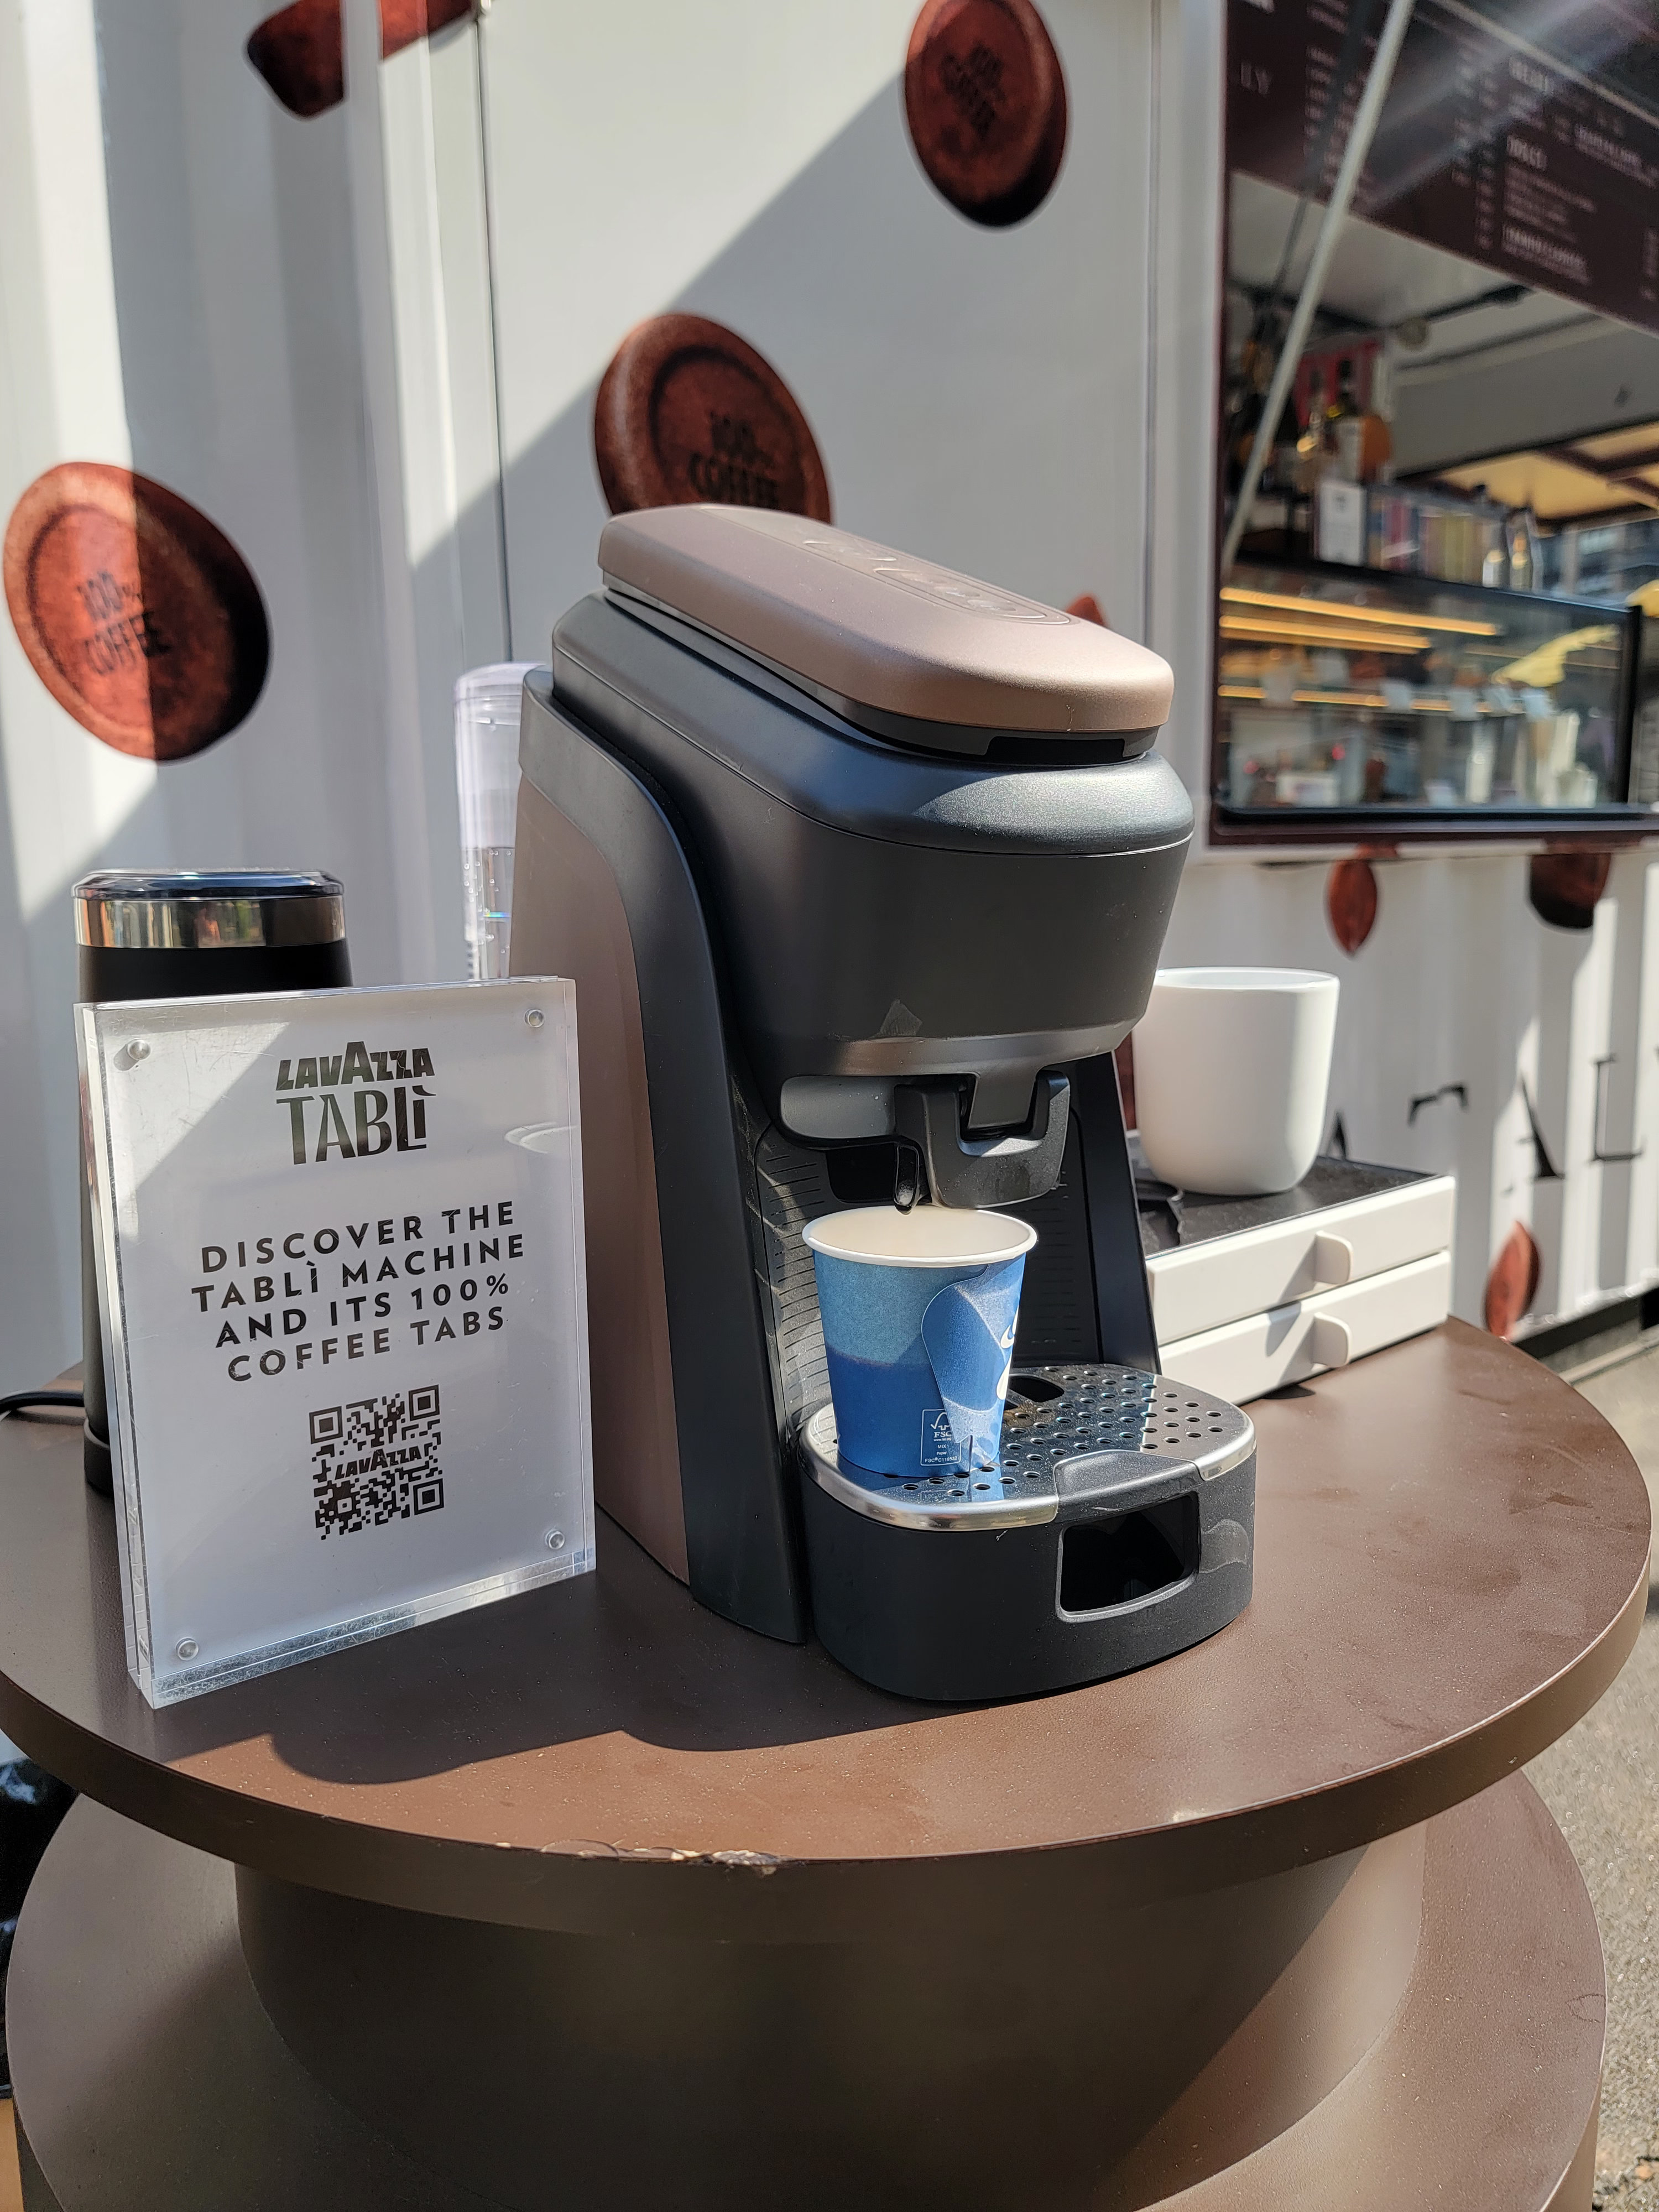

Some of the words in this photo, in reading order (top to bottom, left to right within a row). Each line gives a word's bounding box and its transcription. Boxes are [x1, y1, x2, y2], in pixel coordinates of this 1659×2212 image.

[276, 1041, 435, 1091] LAVAZZA
[276, 1084, 437, 1165] TABLÌ
[191, 1260, 319, 1312] TABLÌ
[342, 1234, 523, 1287] MACHINE
[201, 1215, 423, 1273] DISCOVER
[441, 1201, 514, 1234] THE
[216, 1308, 306, 1348] AND
[330, 1292, 392, 1326] ITS
[411, 1273, 509, 1310] 100%
[228, 1327, 390, 1381] COFFEE
[410, 1306, 504, 1345] TABS
[335, 1446, 422, 1480] LAVAZZA
